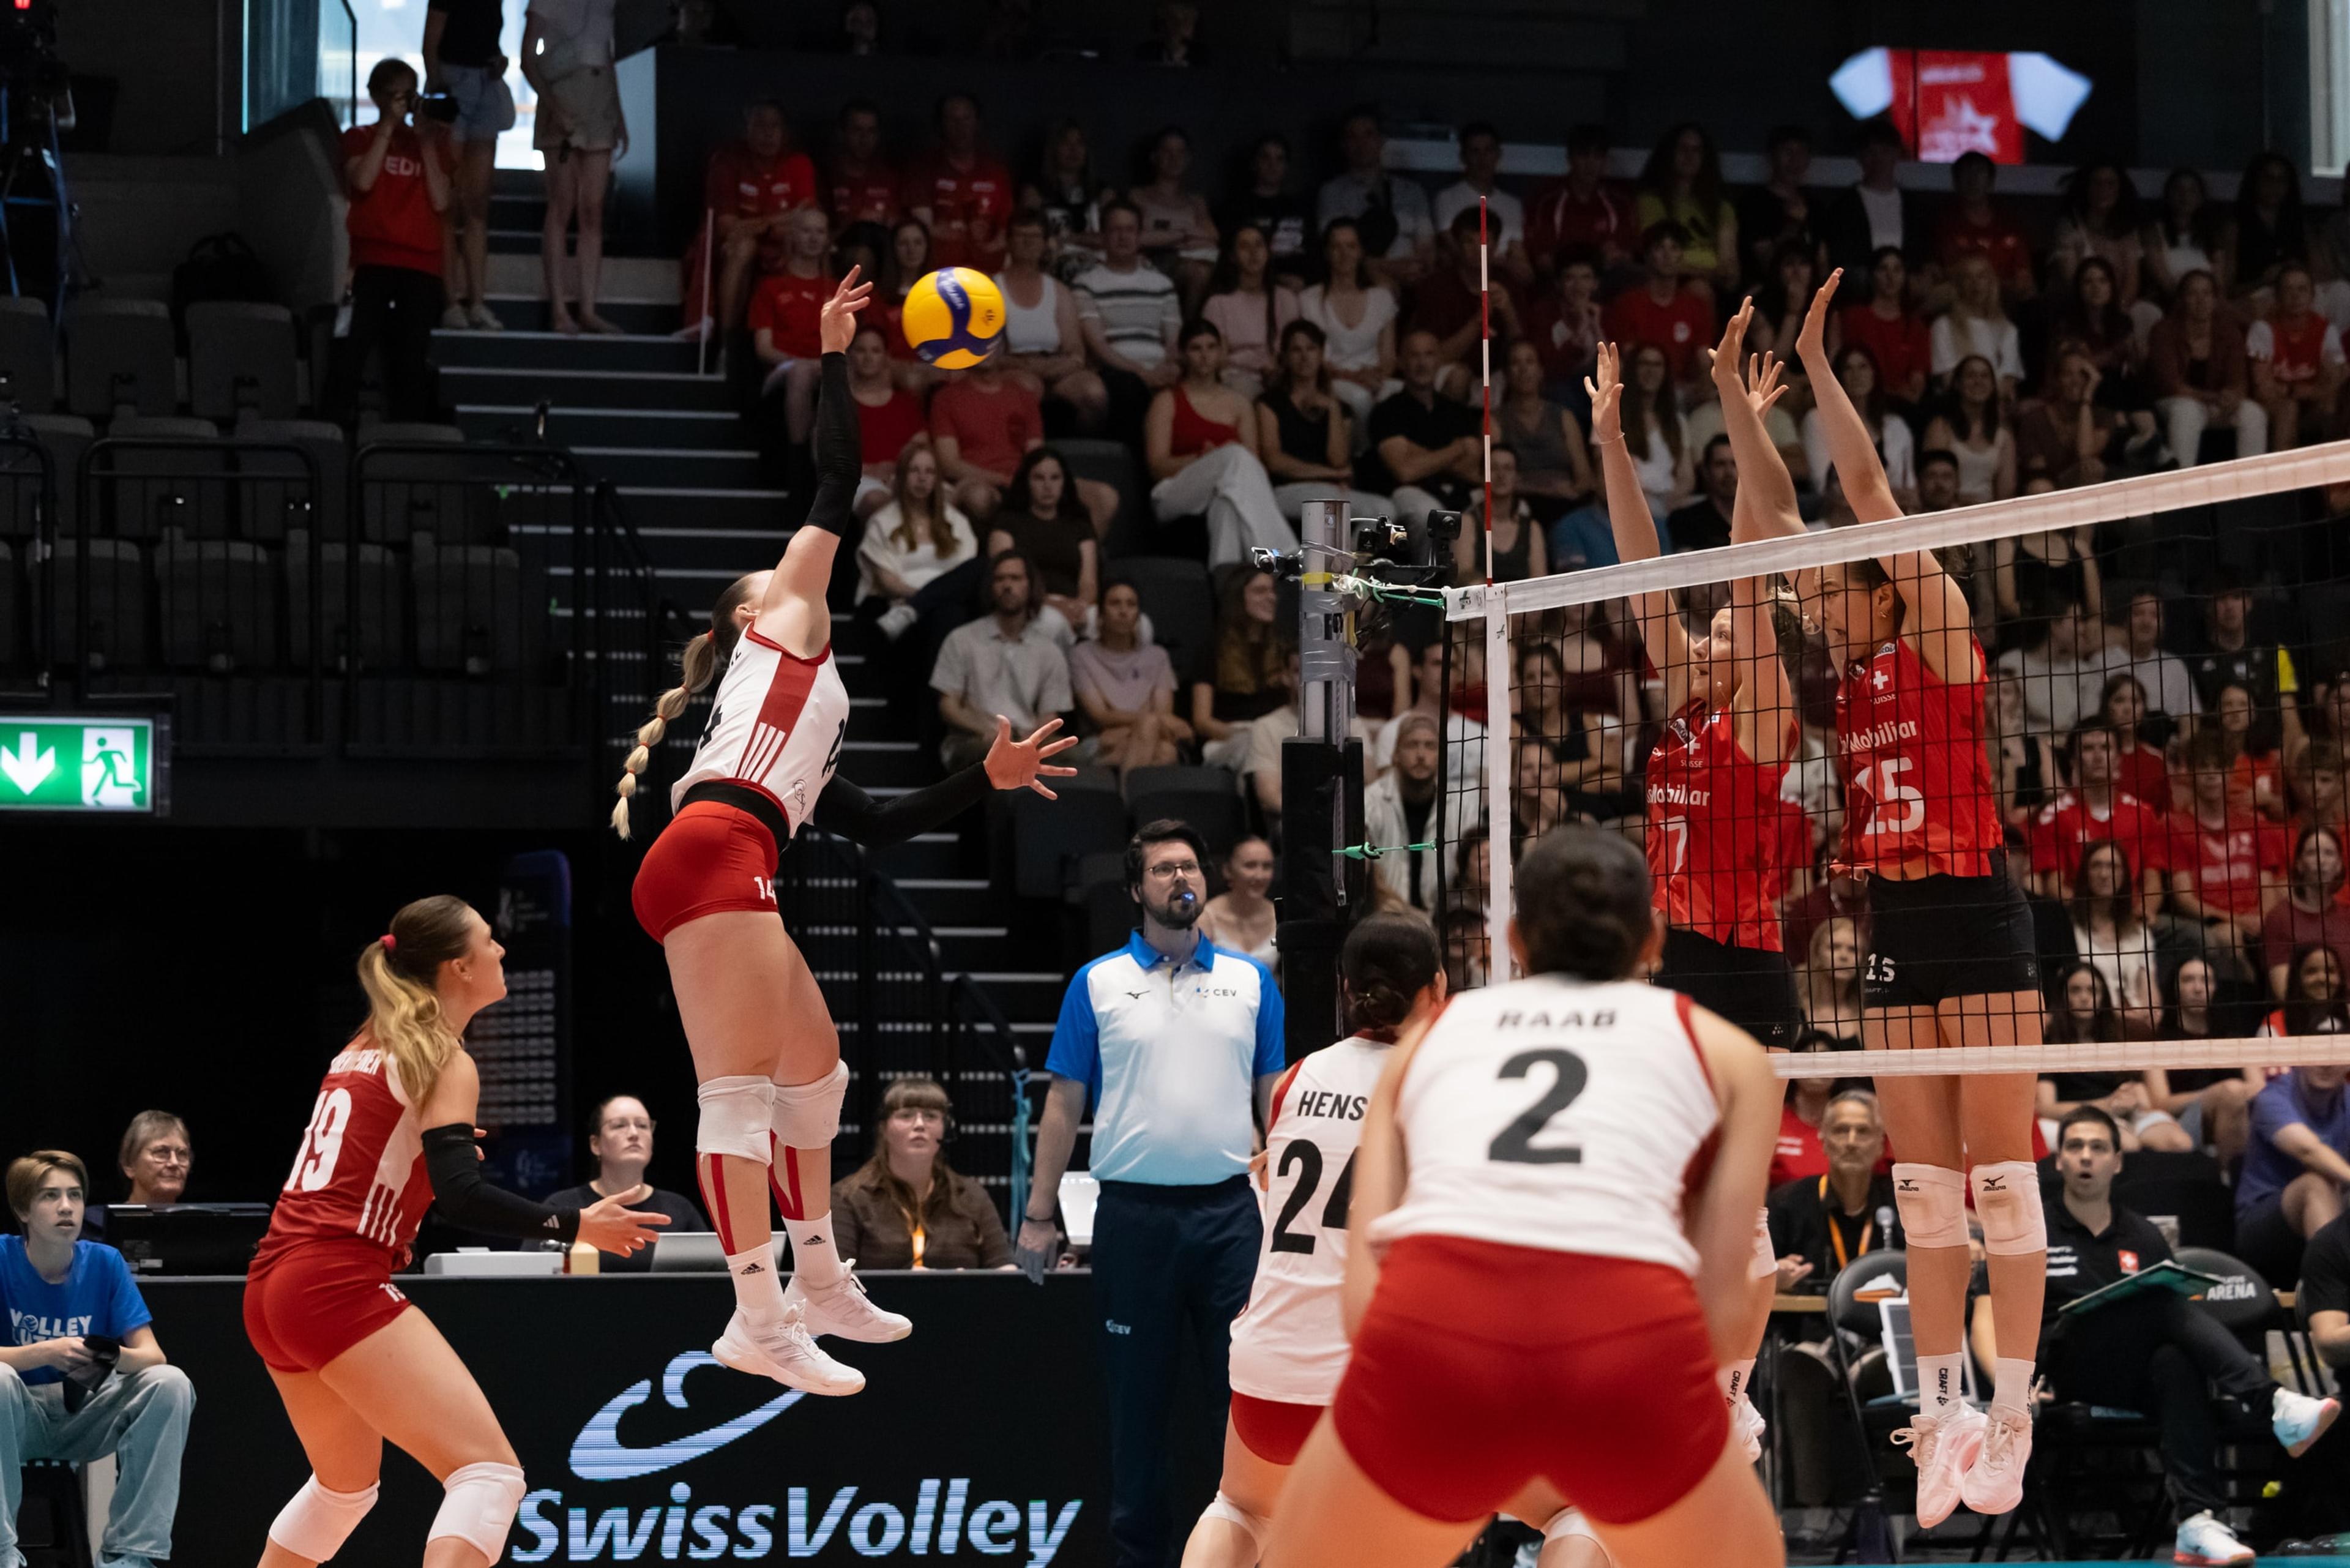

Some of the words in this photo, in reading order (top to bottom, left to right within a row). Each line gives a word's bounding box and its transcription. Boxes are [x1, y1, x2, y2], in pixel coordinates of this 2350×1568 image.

[1855, 757, 1925, 835] 15
[1658, 815, 1687, 883] 7
[754, 876, 777, 905] 14
[1866, 953, 1896, 982] 15
[1497, 1010, 1615, 1028] RAAB
[1297, 1091, 1368, 1121] HENS
[1488, 1048, 1587, 1164] 2
[283, 1088, 352, 1192] 19
[2207, 1282, 2256, 1301] ARENA
[1729, 1370, 1741, 1397] CRAFT
[1939, 1368, 1949, 1394] CRAFT
[512, 1477, 1083, 1568] SwissVolley
